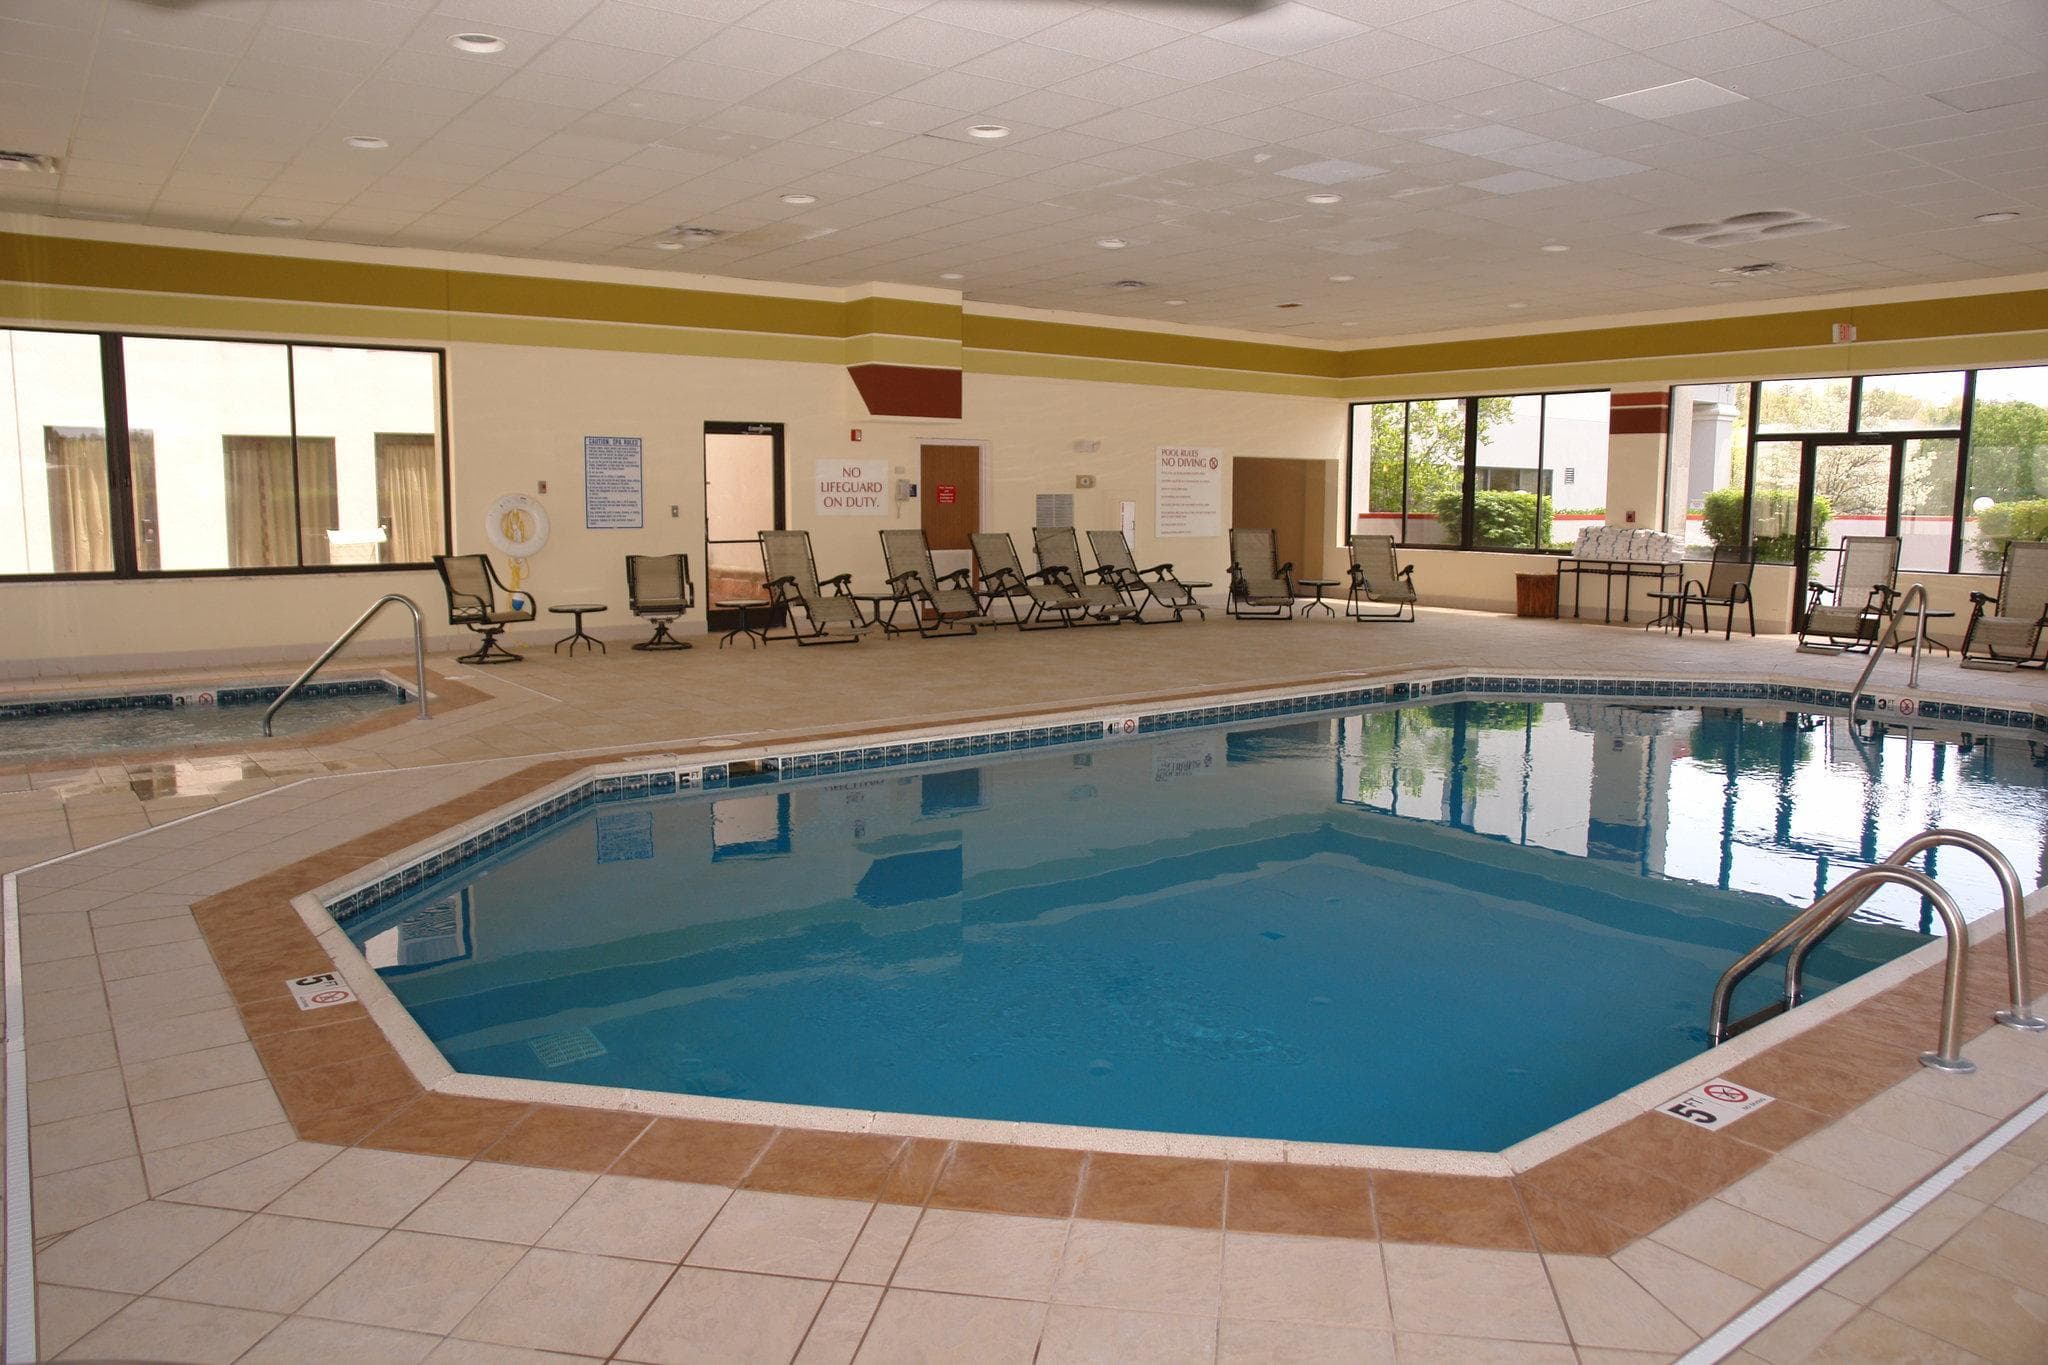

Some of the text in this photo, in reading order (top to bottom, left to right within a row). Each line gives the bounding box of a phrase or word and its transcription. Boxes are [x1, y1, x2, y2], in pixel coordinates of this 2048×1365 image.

[1161, 449, 1199, 457] POOL RULES
[1161, 457, 1206, 468] NO DIVING
[842, 467, 861, 478] NO
[821, 481, 883, 493] LIFEGUARD
[823, 496, 880, 508] ON DUTY.
[1878, 699, 1887, 709] 3
[296, 974, 335, 986] 5
[1667, 1097, 1718, 1124] 5 FT
